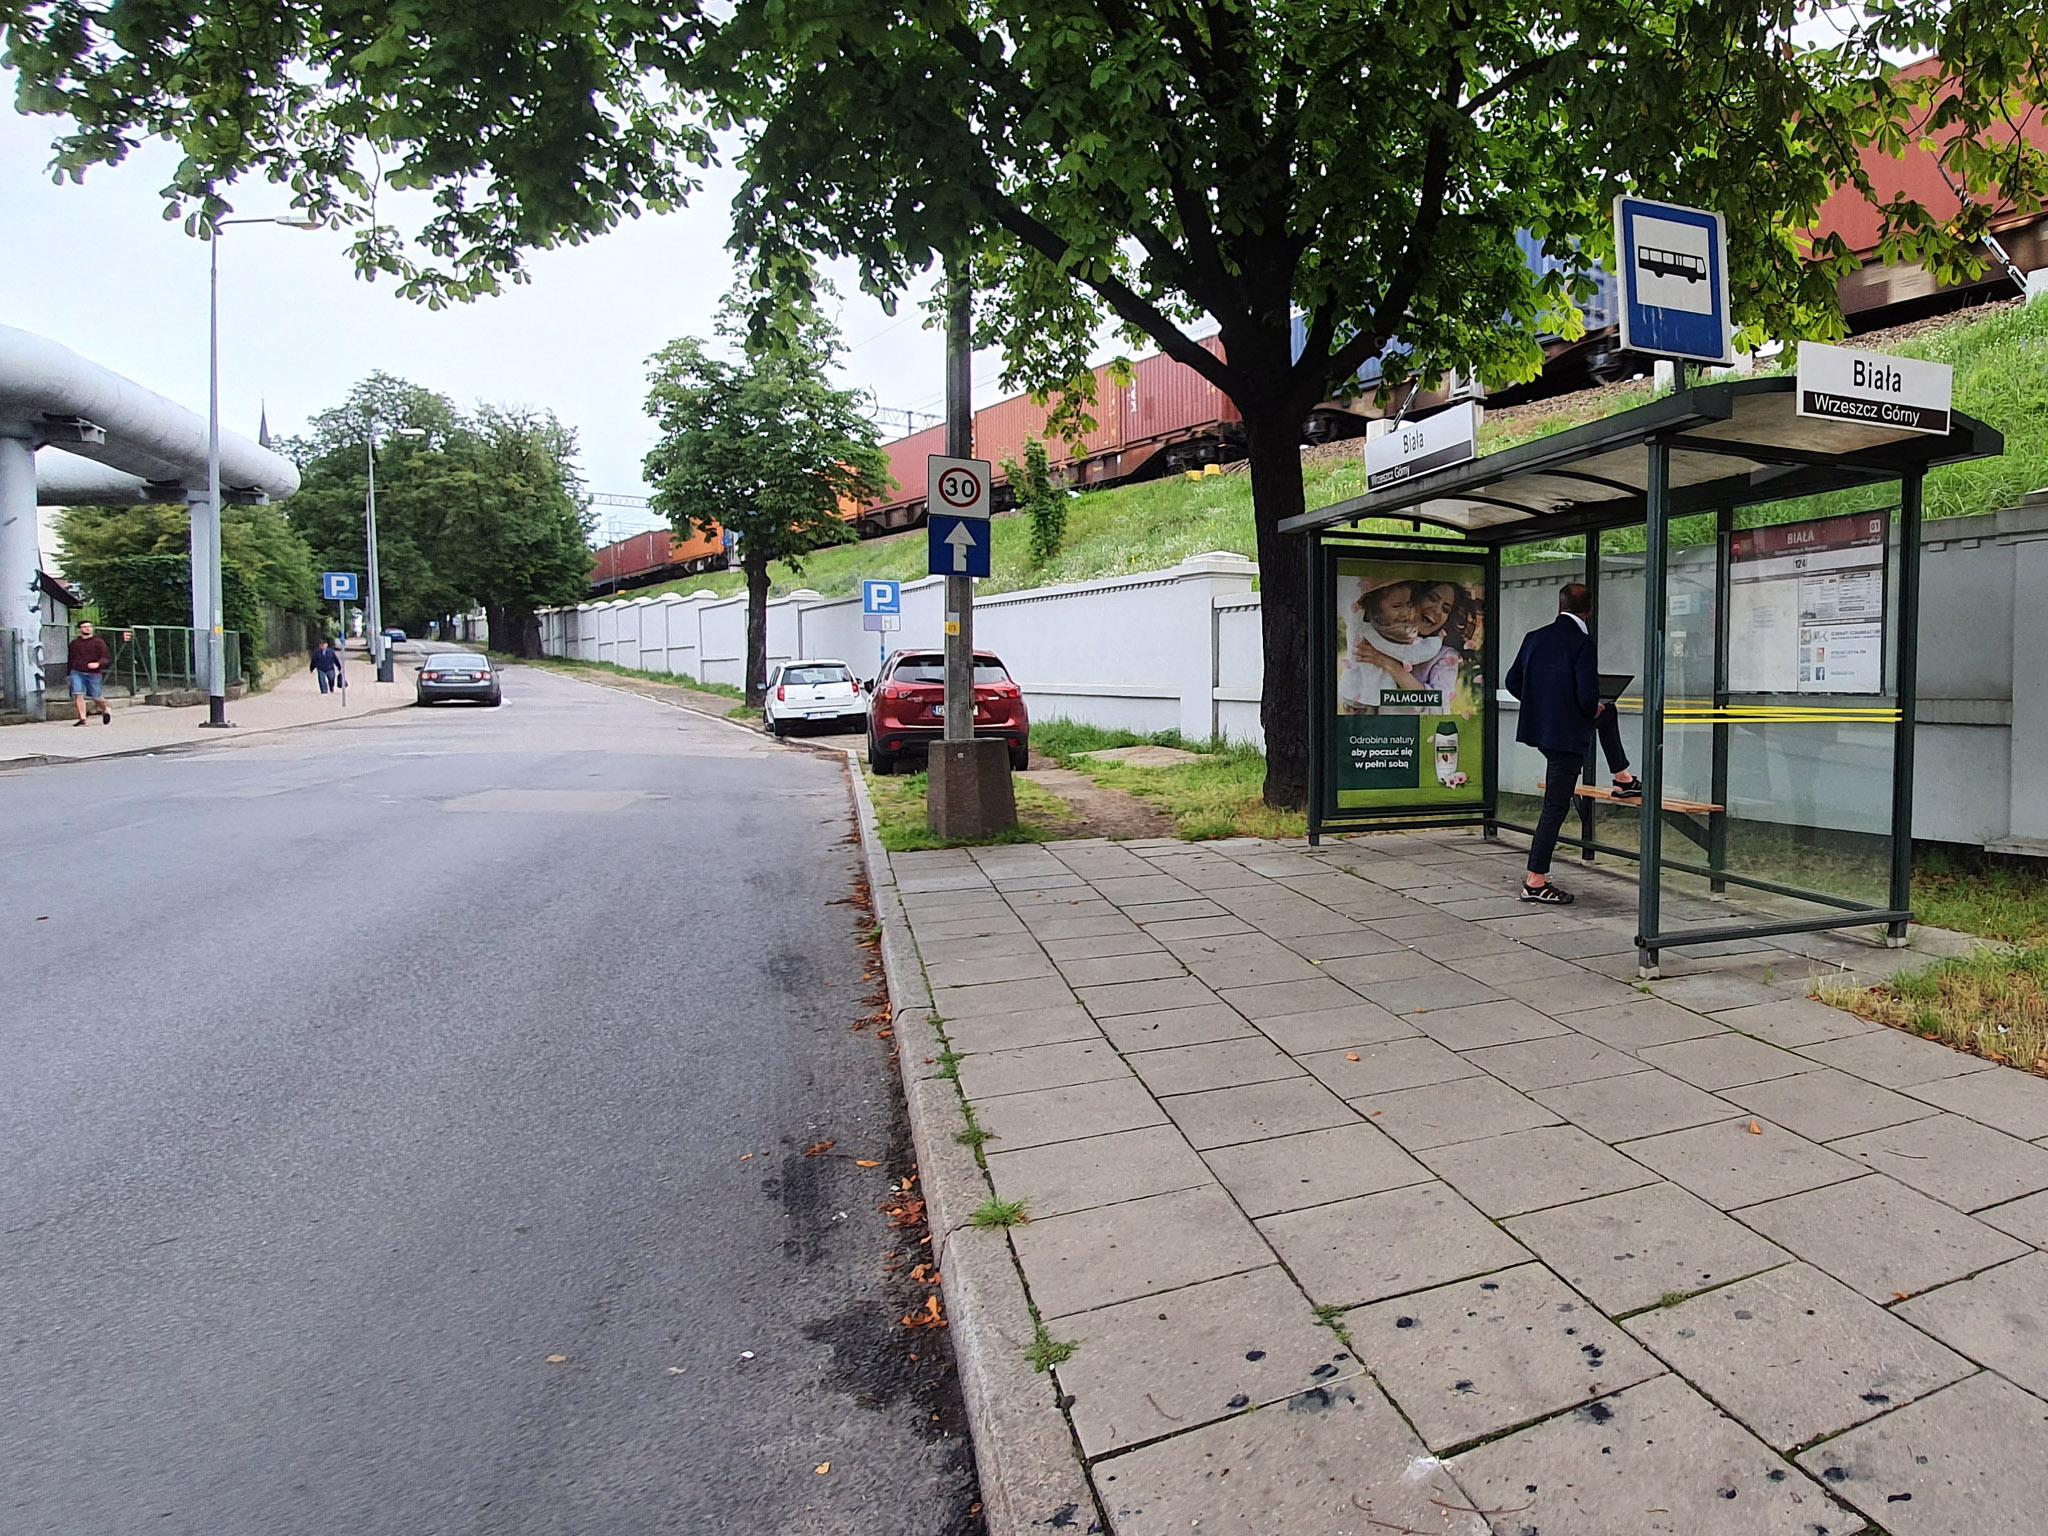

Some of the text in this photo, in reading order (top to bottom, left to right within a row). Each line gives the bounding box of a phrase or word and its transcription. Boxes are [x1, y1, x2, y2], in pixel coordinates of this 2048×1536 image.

[1853, 359, 1902, 392] Biała
[1814, 394, 1921, 427] Wrzeszcz Górny
[1403, 429, 1424, 454] Biała
[945, 477, 975, 498] 30
[1787, 530, 1815, 545] BIAŁA
[331, 575, 350, 597] P
[871, 584, 893, 611] P
[1383, 693, 1440, 703] PALMOLIVE
[1349, 735, 1415, 746] Odrobina natury
[1351, 747, 1413, 758] aby poczuć się
[1355, 760, 1409, 770] w pełni sobą
